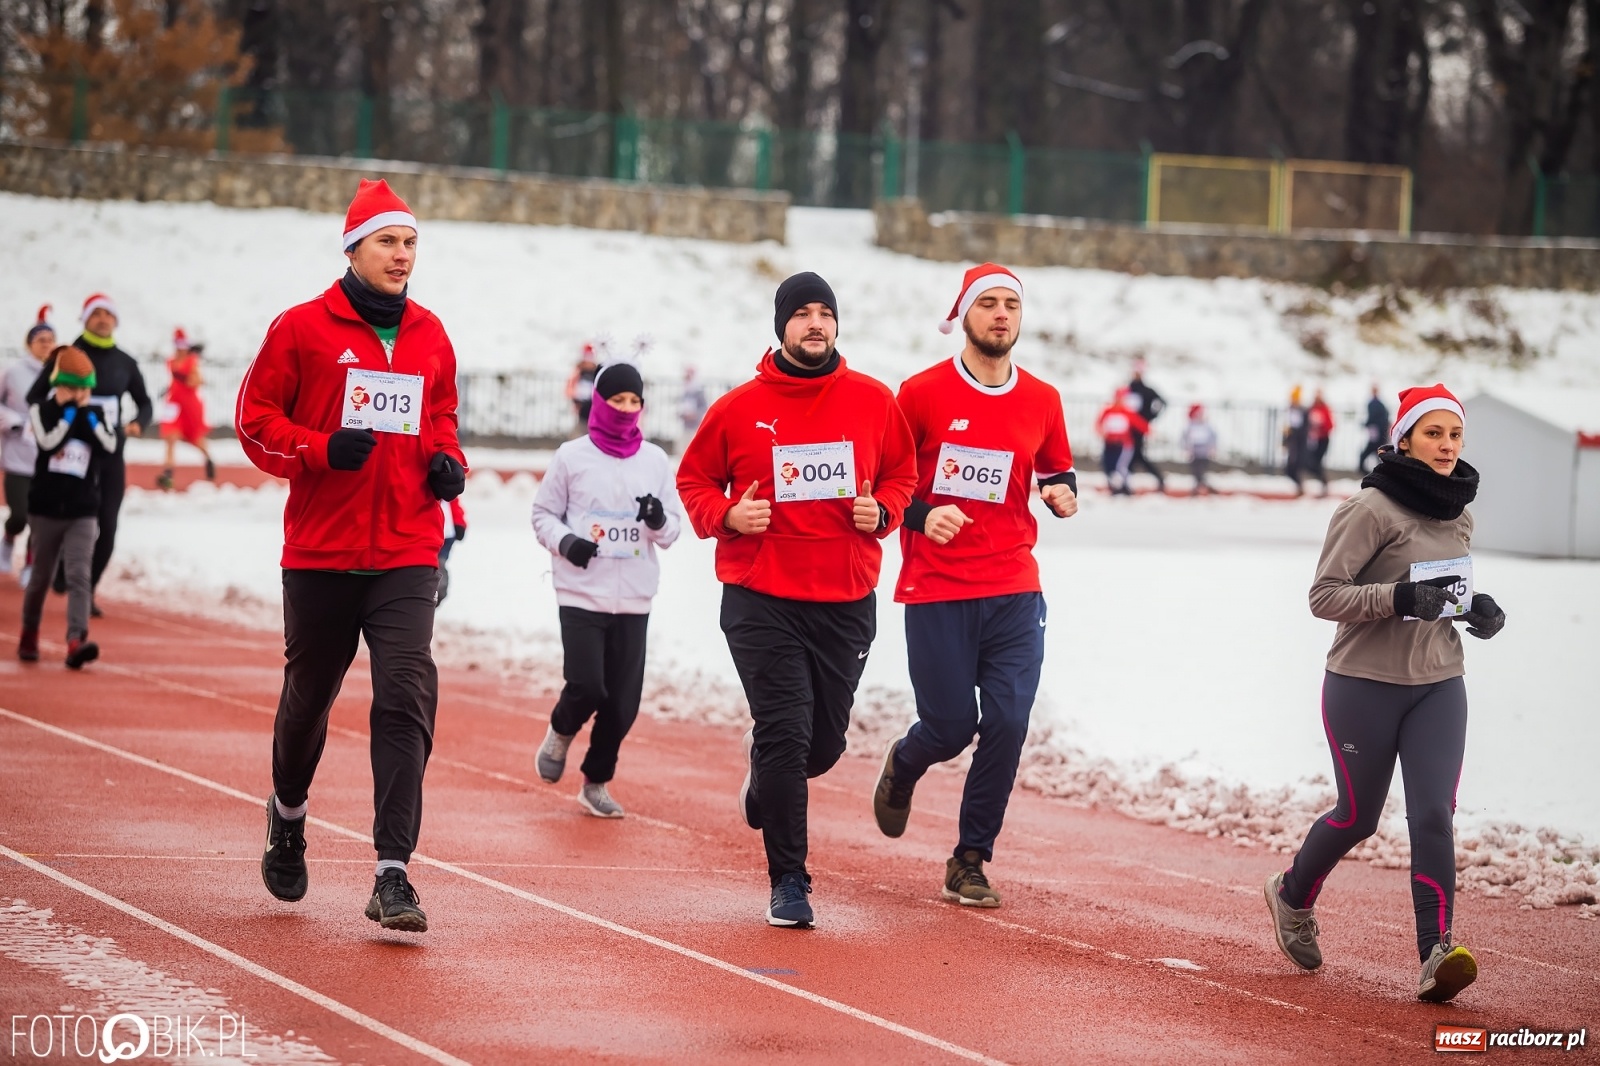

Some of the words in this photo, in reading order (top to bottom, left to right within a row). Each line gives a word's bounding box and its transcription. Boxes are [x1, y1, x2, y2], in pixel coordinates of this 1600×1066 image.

[373, 392, 411, 414] 013
[802, 462, 847, 482] 004
[962, 465, 1003, 485] 065
[608, 527, 640, 542] 018
